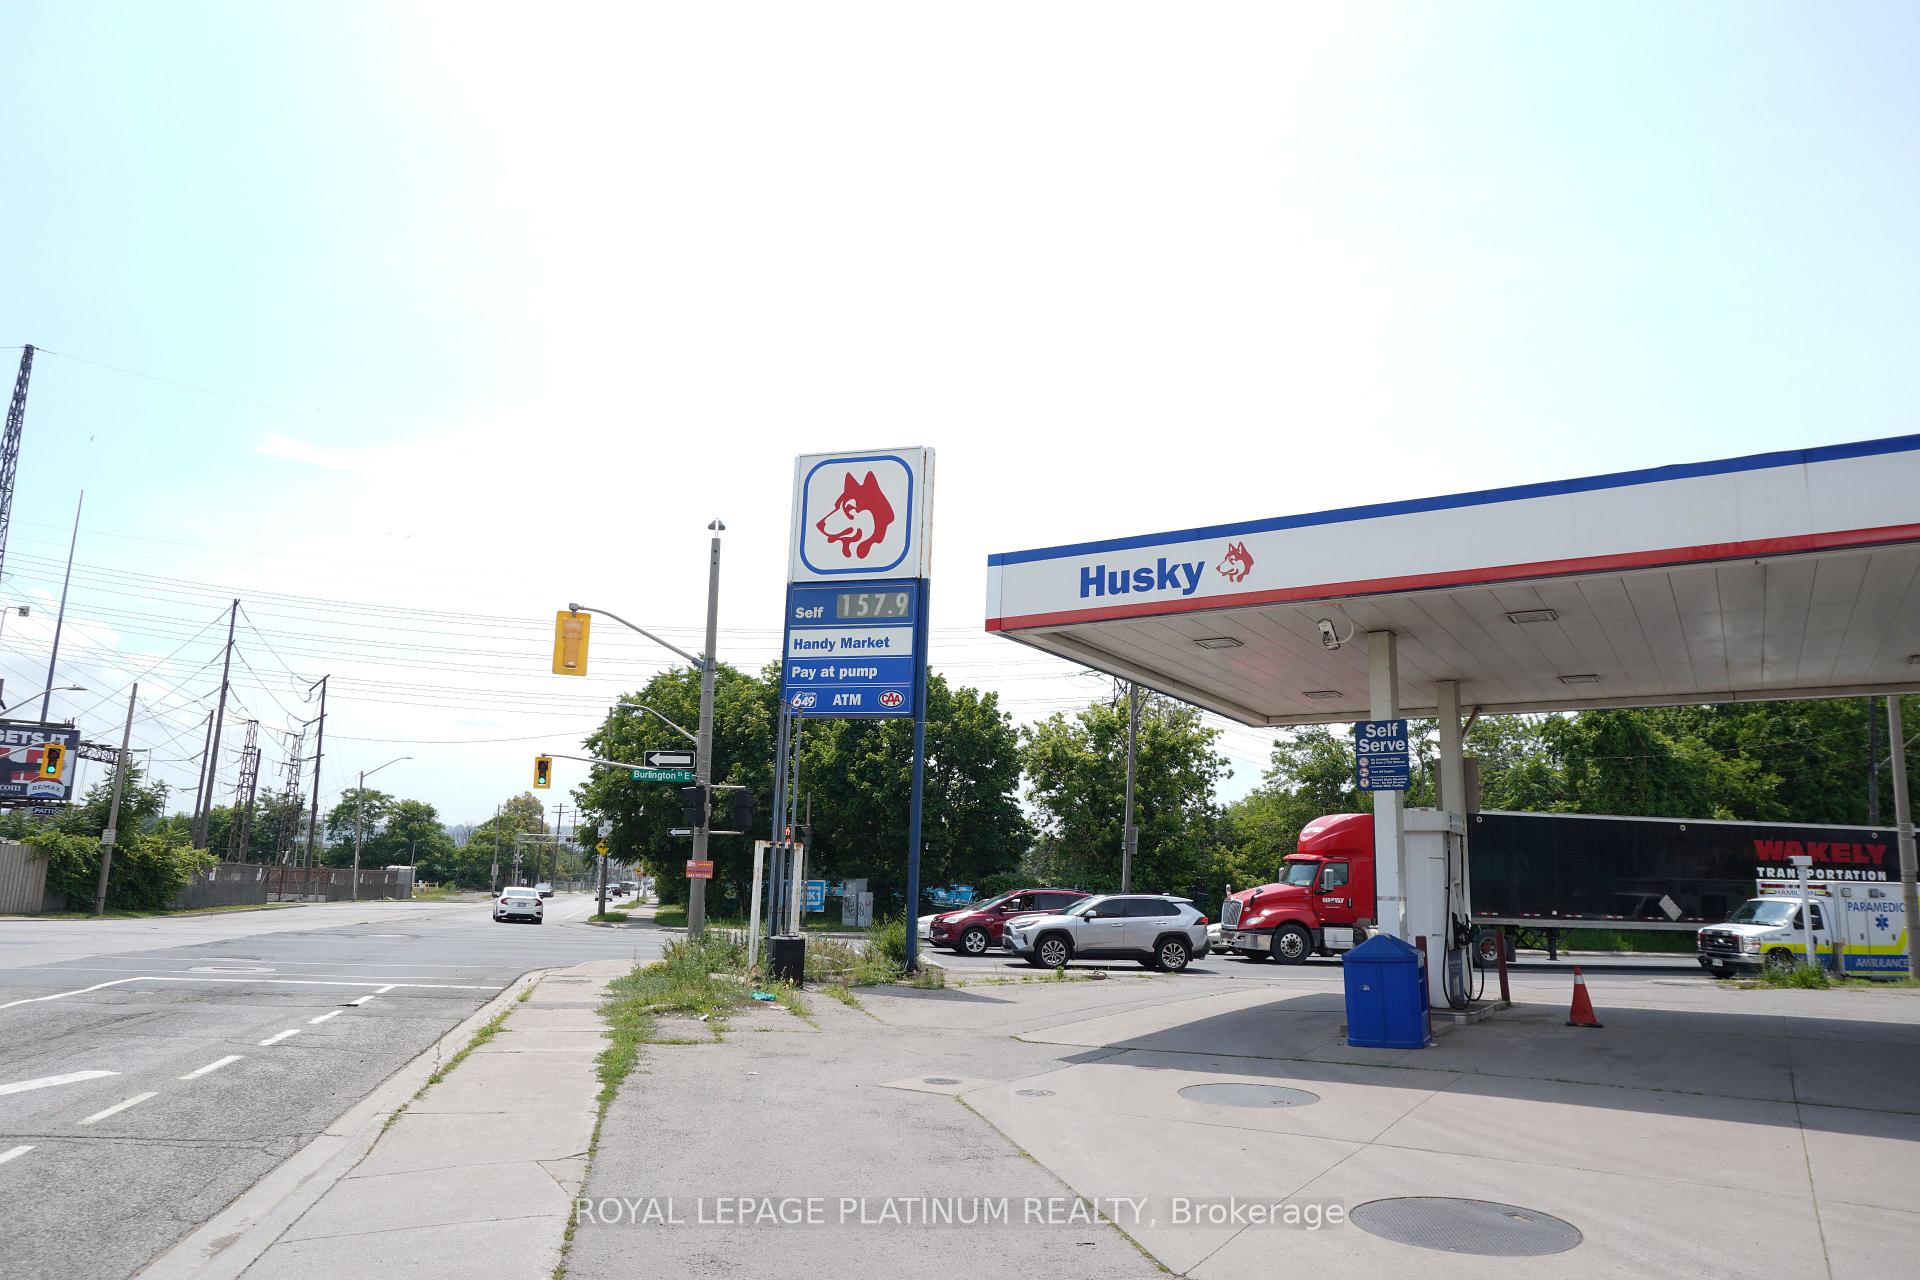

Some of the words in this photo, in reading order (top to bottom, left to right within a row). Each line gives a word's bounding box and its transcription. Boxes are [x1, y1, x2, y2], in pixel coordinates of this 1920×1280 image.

[1080, 557, 1205, 598] Husky
[795, 606, 824, 619] Self
[842, 592, 908, 617] 157.9
[793, 638, 836, 652] Handy
[840, 636, 890, 649] Market
[791, 666, 816, 680] Pay
[820, 665, 835, 678] at
[840, 666, 878, 680] pump
[832, 694, 861, 706] ATM
[881, 692, 900, 706] CAA
[1365, 723, 1398, 738] Self
[50, 733, 70, 746] IT
[1359, 738, 1406, 752] Serve
[633, 770, 676, 781] Burlington
[684, 772, 690, 780] E
[32, 784, 61, 792] RE/MAX
[1754, 840, 1887, 864] WAKELY
[1856, 958, 1909, 968] AMBULANCE
